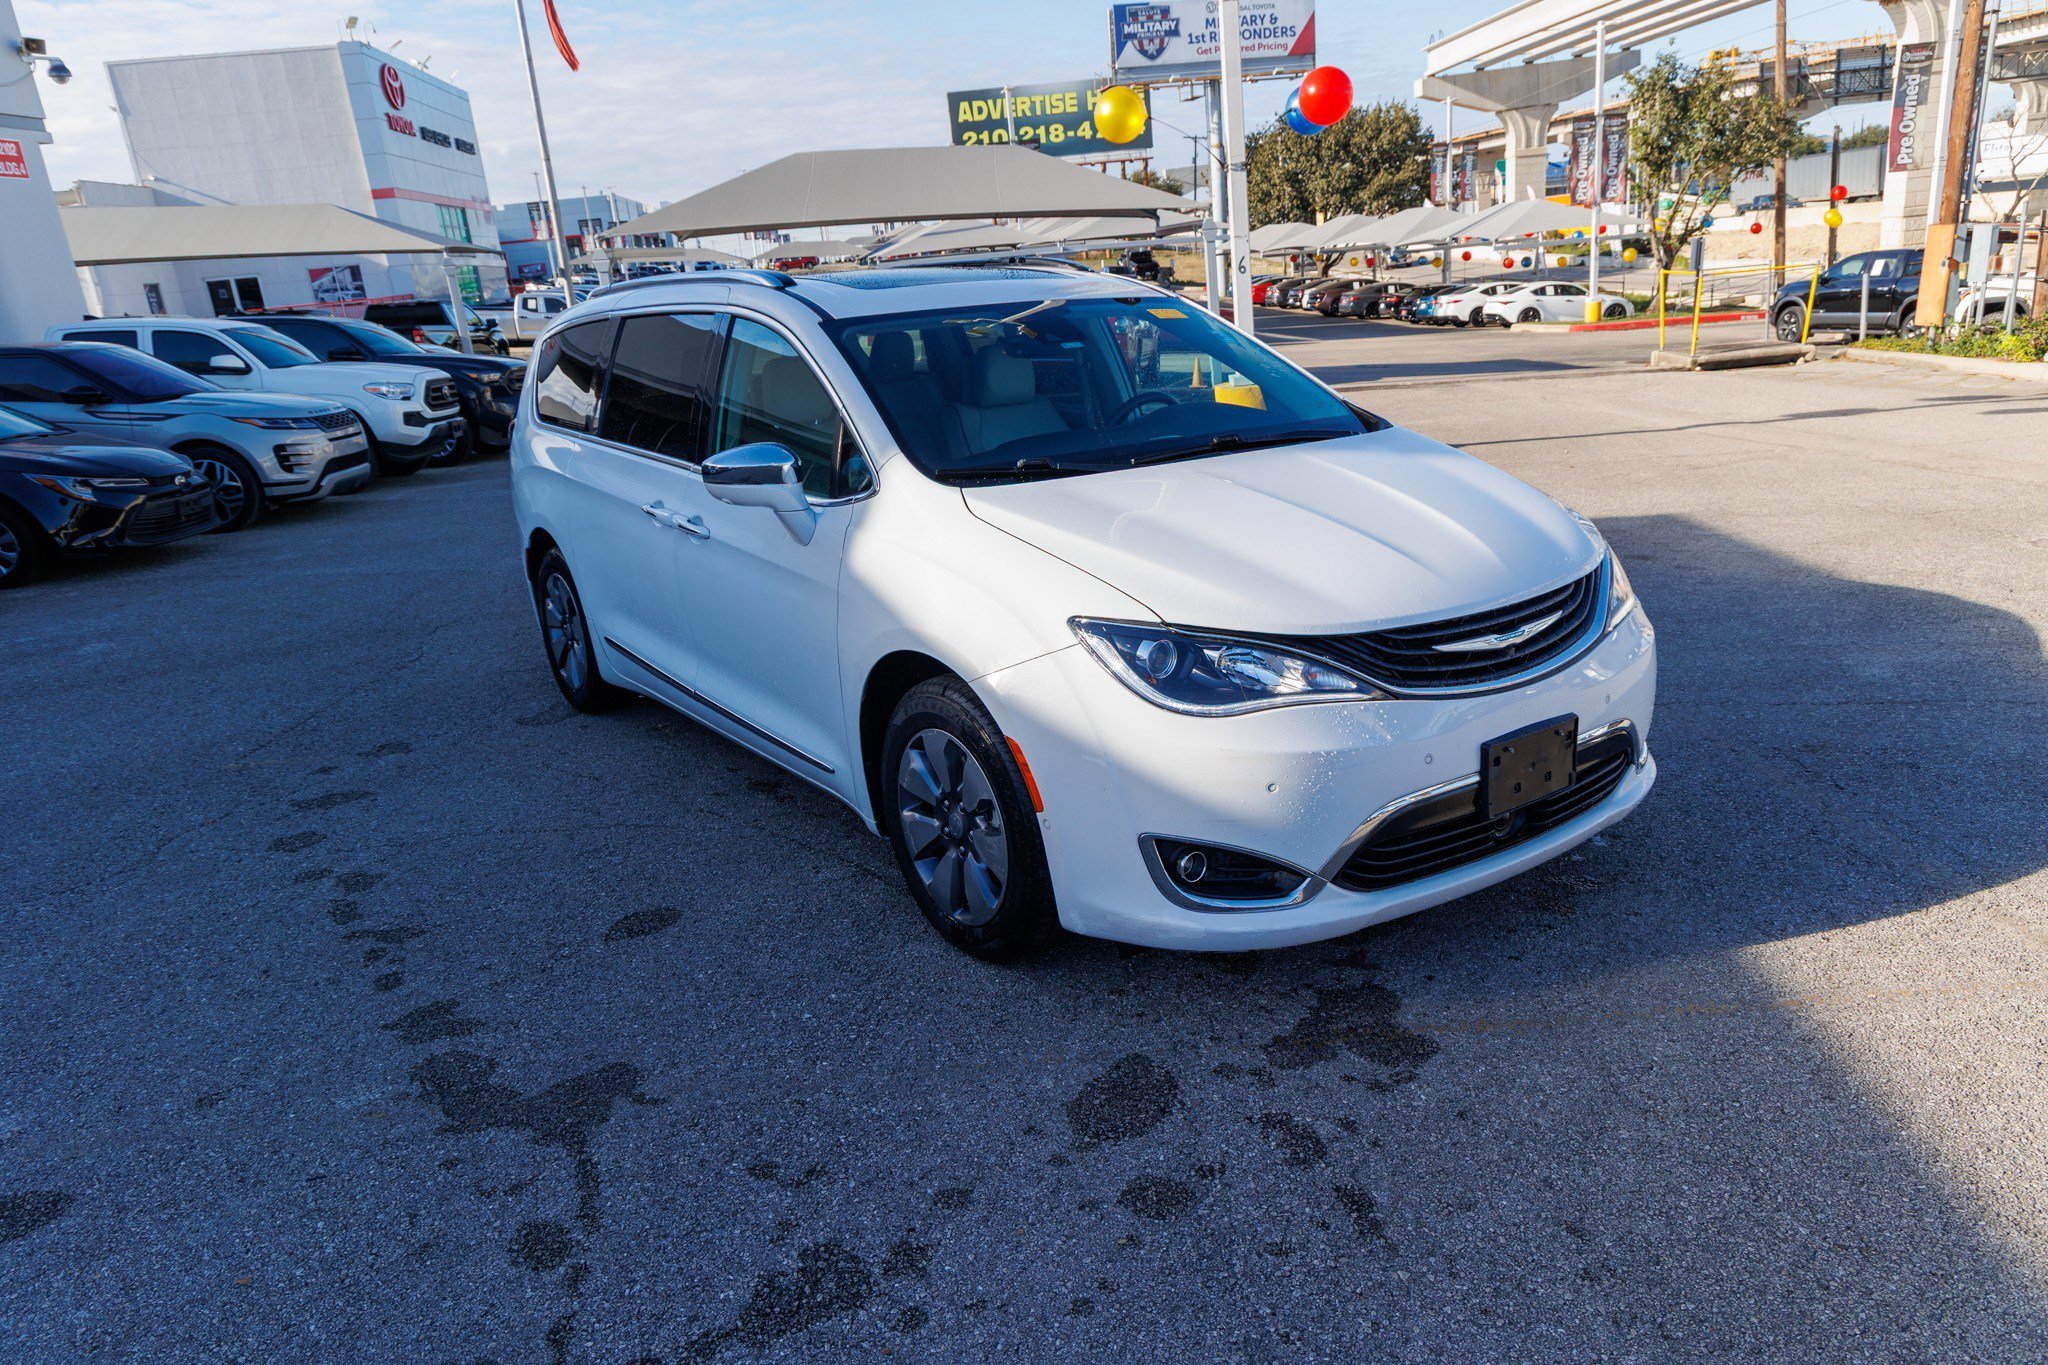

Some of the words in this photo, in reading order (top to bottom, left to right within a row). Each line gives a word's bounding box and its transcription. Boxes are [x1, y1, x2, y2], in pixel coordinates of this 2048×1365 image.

[1252, 3, 1275, 11] TOYOTA
[1123, 20, 1177, 34] MILITARY
[1205, 13, 1266, 29] MIARY
[1269, 12, 1278, 25] &
[1187, 32, 1206, 44] 1st
[1209, 25, 1296, 43] RONDERS
[1196, 46, 1212, 55] Get
[1257, 42, 1288, 54] Pricing
[957, 91, 1078, 123] ADVERTISE
[1898, 73, 1921, 133] Owned
[1576, 136, 1589, 178] Owned
[1606, 134, 1620, 176] Owned
[1897, 137, 1914, 165] Pre
[1575, 180, 1588, 201] Pre
[1605, 178, 1618, 198] Pre
[1238, 255, 1247, 275] 6
